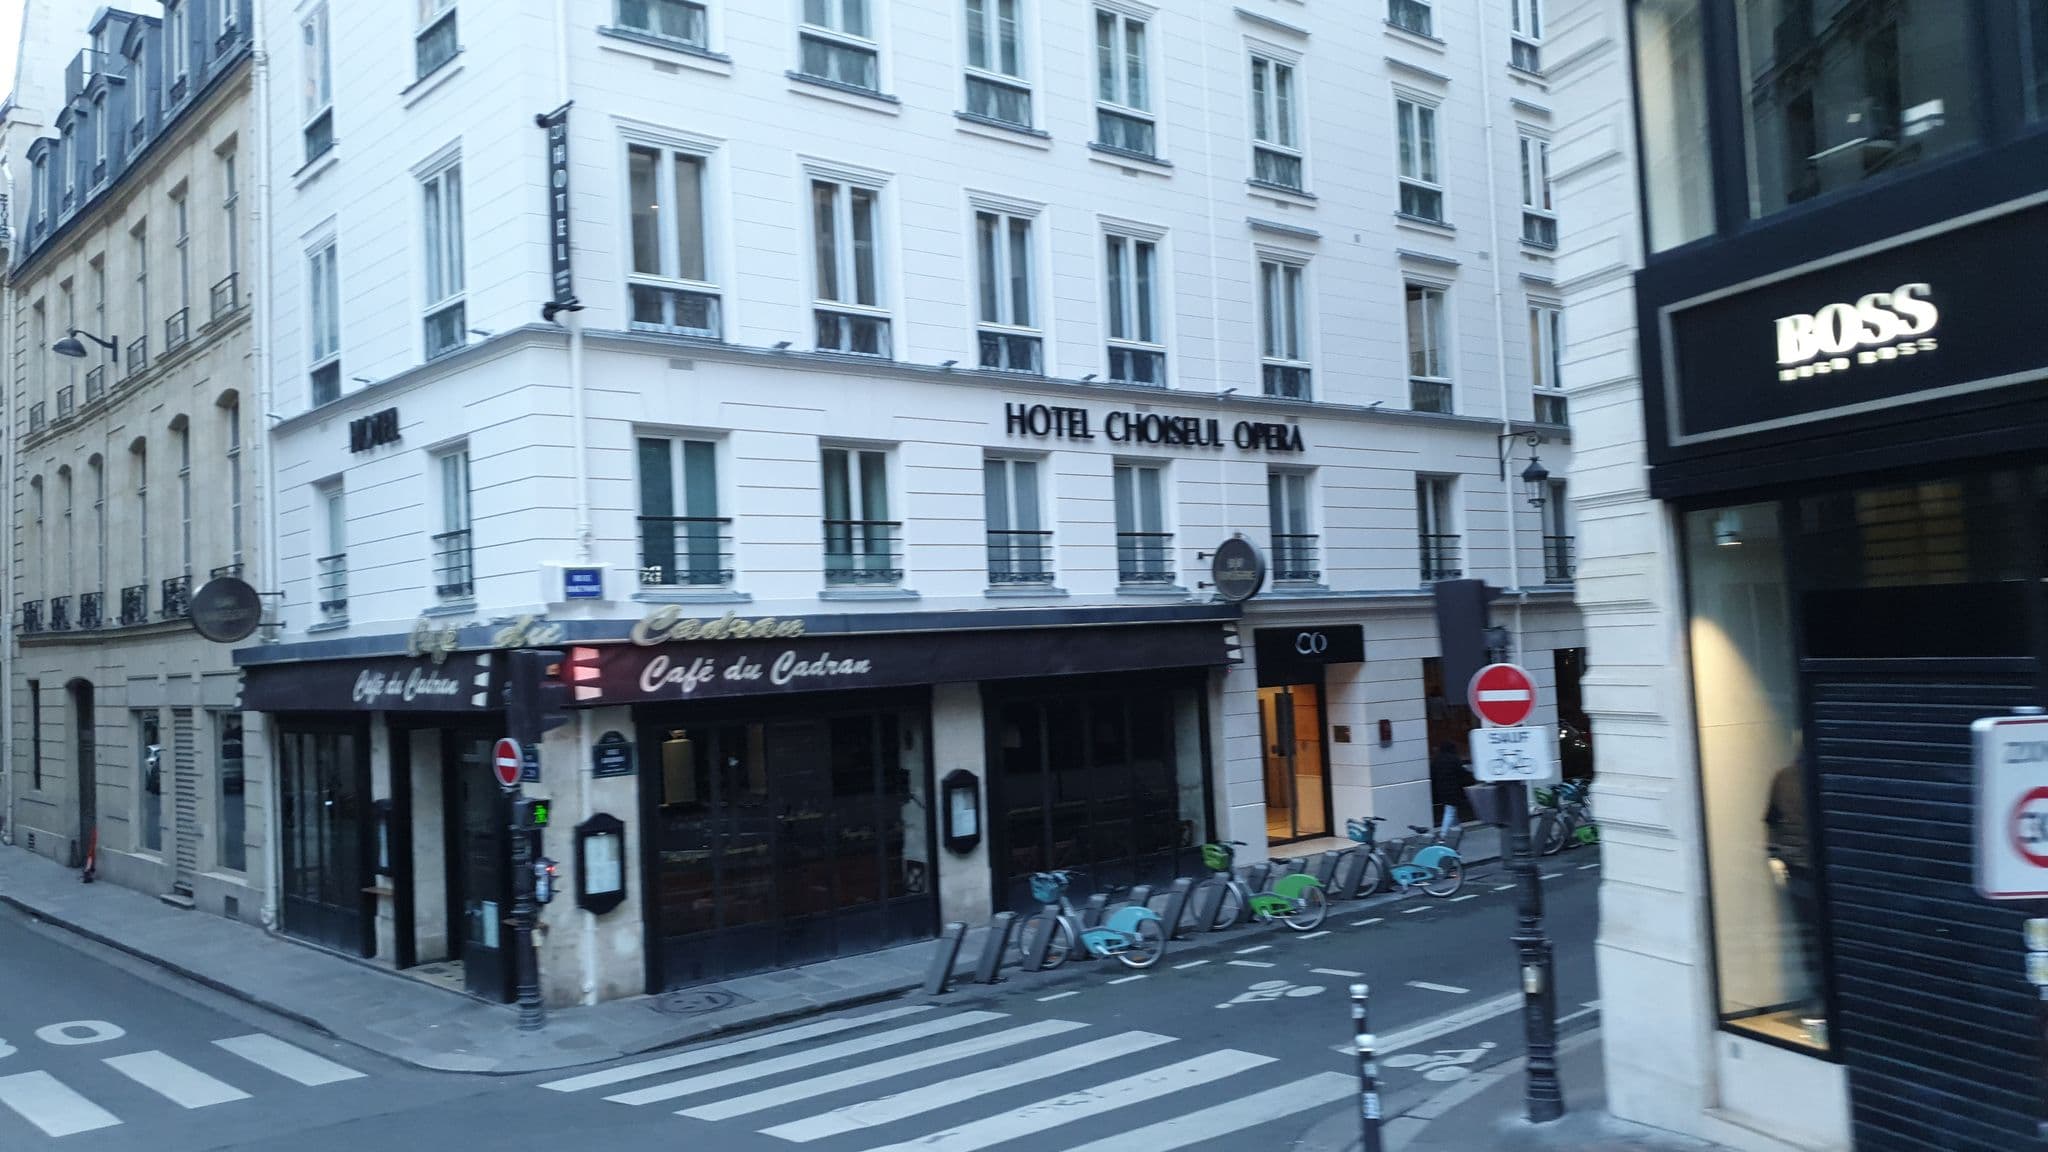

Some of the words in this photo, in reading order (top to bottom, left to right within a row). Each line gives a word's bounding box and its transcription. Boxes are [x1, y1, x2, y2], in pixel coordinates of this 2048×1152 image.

[1774, 283, 1938, 364] BOSS
[1857, 337, 1938, 365] BOSS
[1005, 402, 1095, 439] HOTEL
[1105, 411, 1225, 448] CHOISEUL
[1233, 420, 1305, 452] OPERA
[630, 604, 805, 646] Cadran
[352, 669, 386, 704] Café
[385, 671, 404, 695] du
[403, 667, 460, 701] Cadran
[640, 655, 716, 693] Café
[724, 656, 764, 682] du
[770, 650, 872, 685] Cadran
[1488, 731, 1531, 744] SAUF
